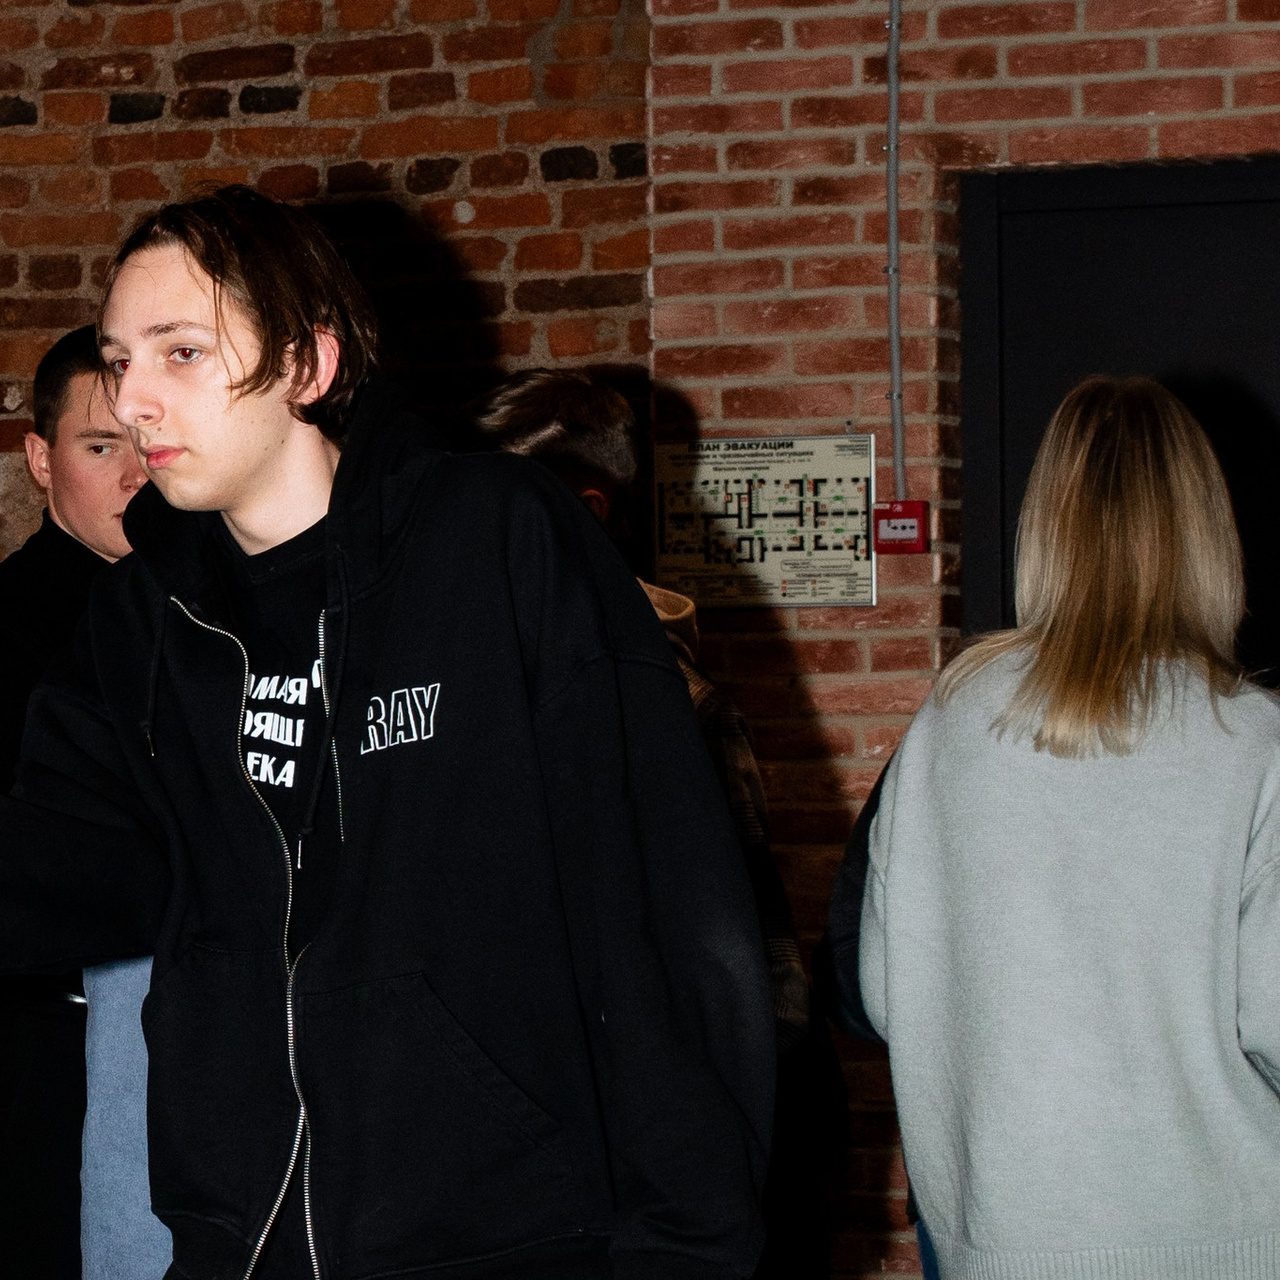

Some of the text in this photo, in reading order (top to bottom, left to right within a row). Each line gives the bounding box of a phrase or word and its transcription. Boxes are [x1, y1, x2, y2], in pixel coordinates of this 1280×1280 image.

[688, 440, 794, 452] ПЛАН ЭВАКУАЦИИ
[359, 682, 442, 755] RAY
